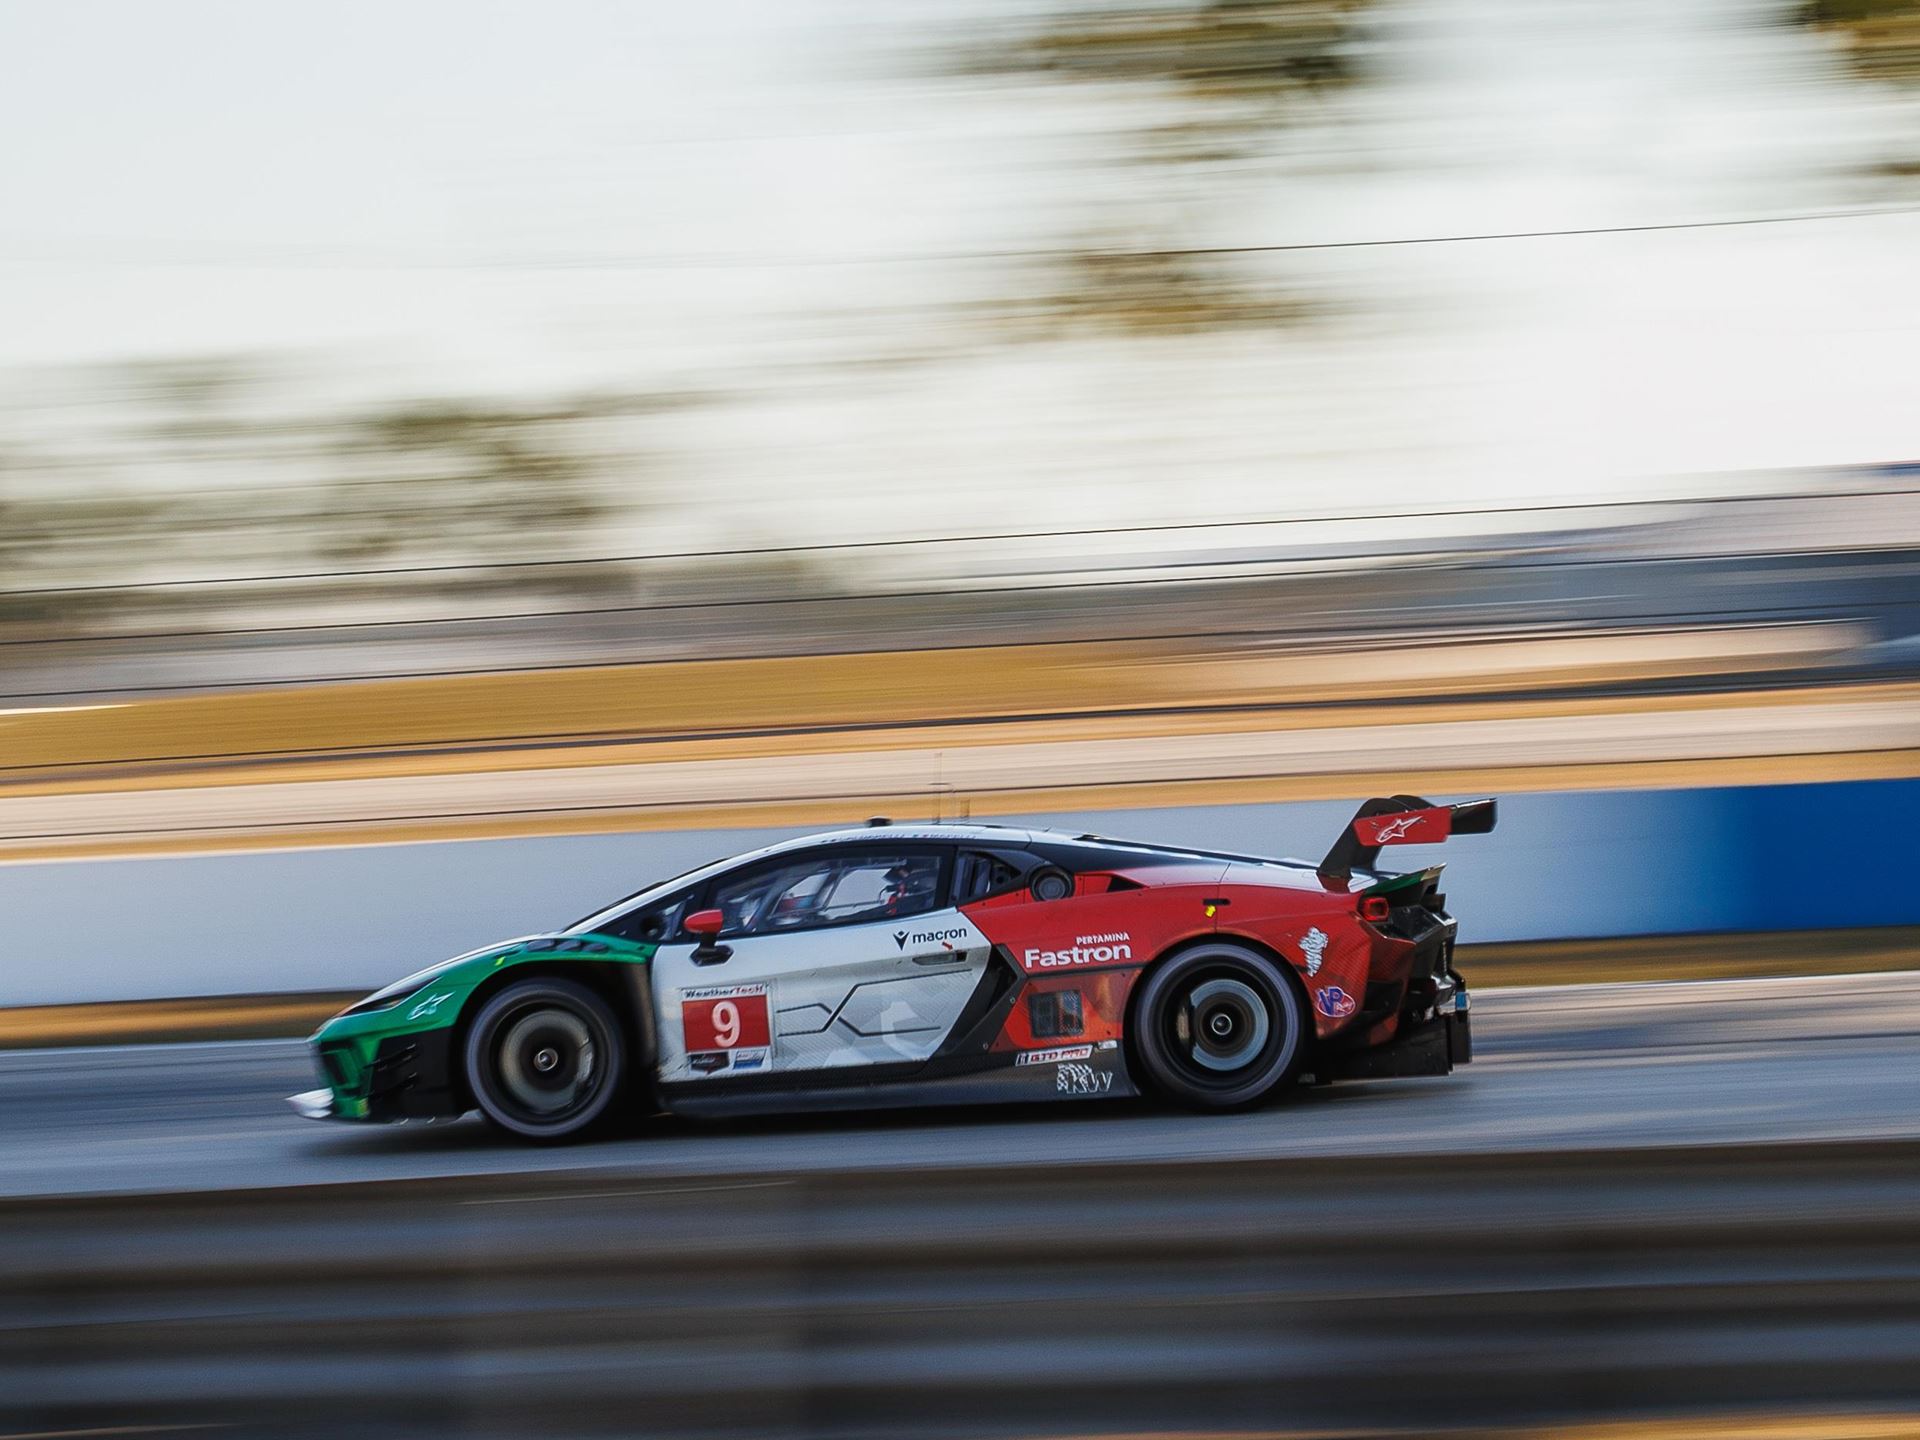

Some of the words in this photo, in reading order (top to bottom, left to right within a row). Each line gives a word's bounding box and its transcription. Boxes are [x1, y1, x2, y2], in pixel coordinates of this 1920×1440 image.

[912, 927, 968, 944] macron
[1075, 931, 1130, 946] PERTAMINA
[1024, 944, 1132, 969] Fastron
[711, 1000, 741, 1049] 9
